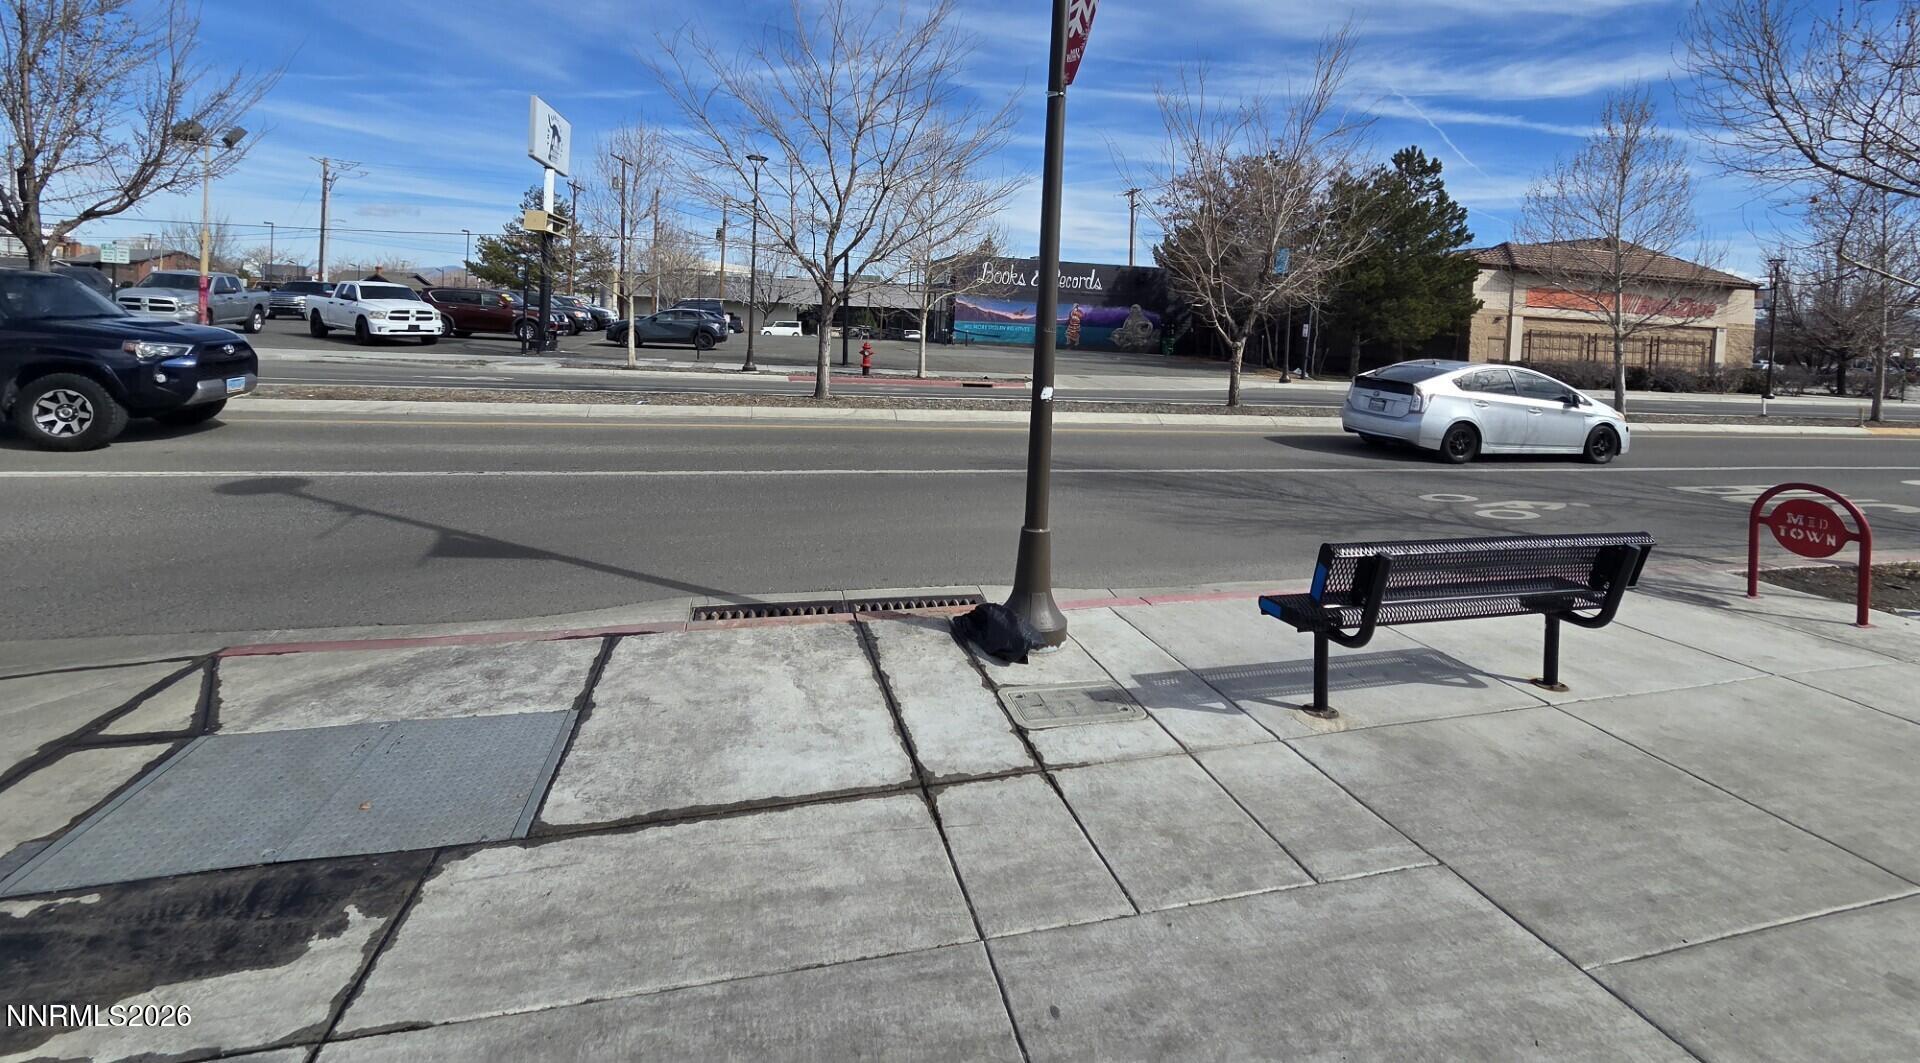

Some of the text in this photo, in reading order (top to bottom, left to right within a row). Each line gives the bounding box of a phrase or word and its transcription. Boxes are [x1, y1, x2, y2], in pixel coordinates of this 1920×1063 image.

[976, 261, 1026, 286] Books
[1057, 268, 1103, 290] ecords
[1786, 512, 1829, 530] MID
[1777, 525, 1837, 547] TOWN
